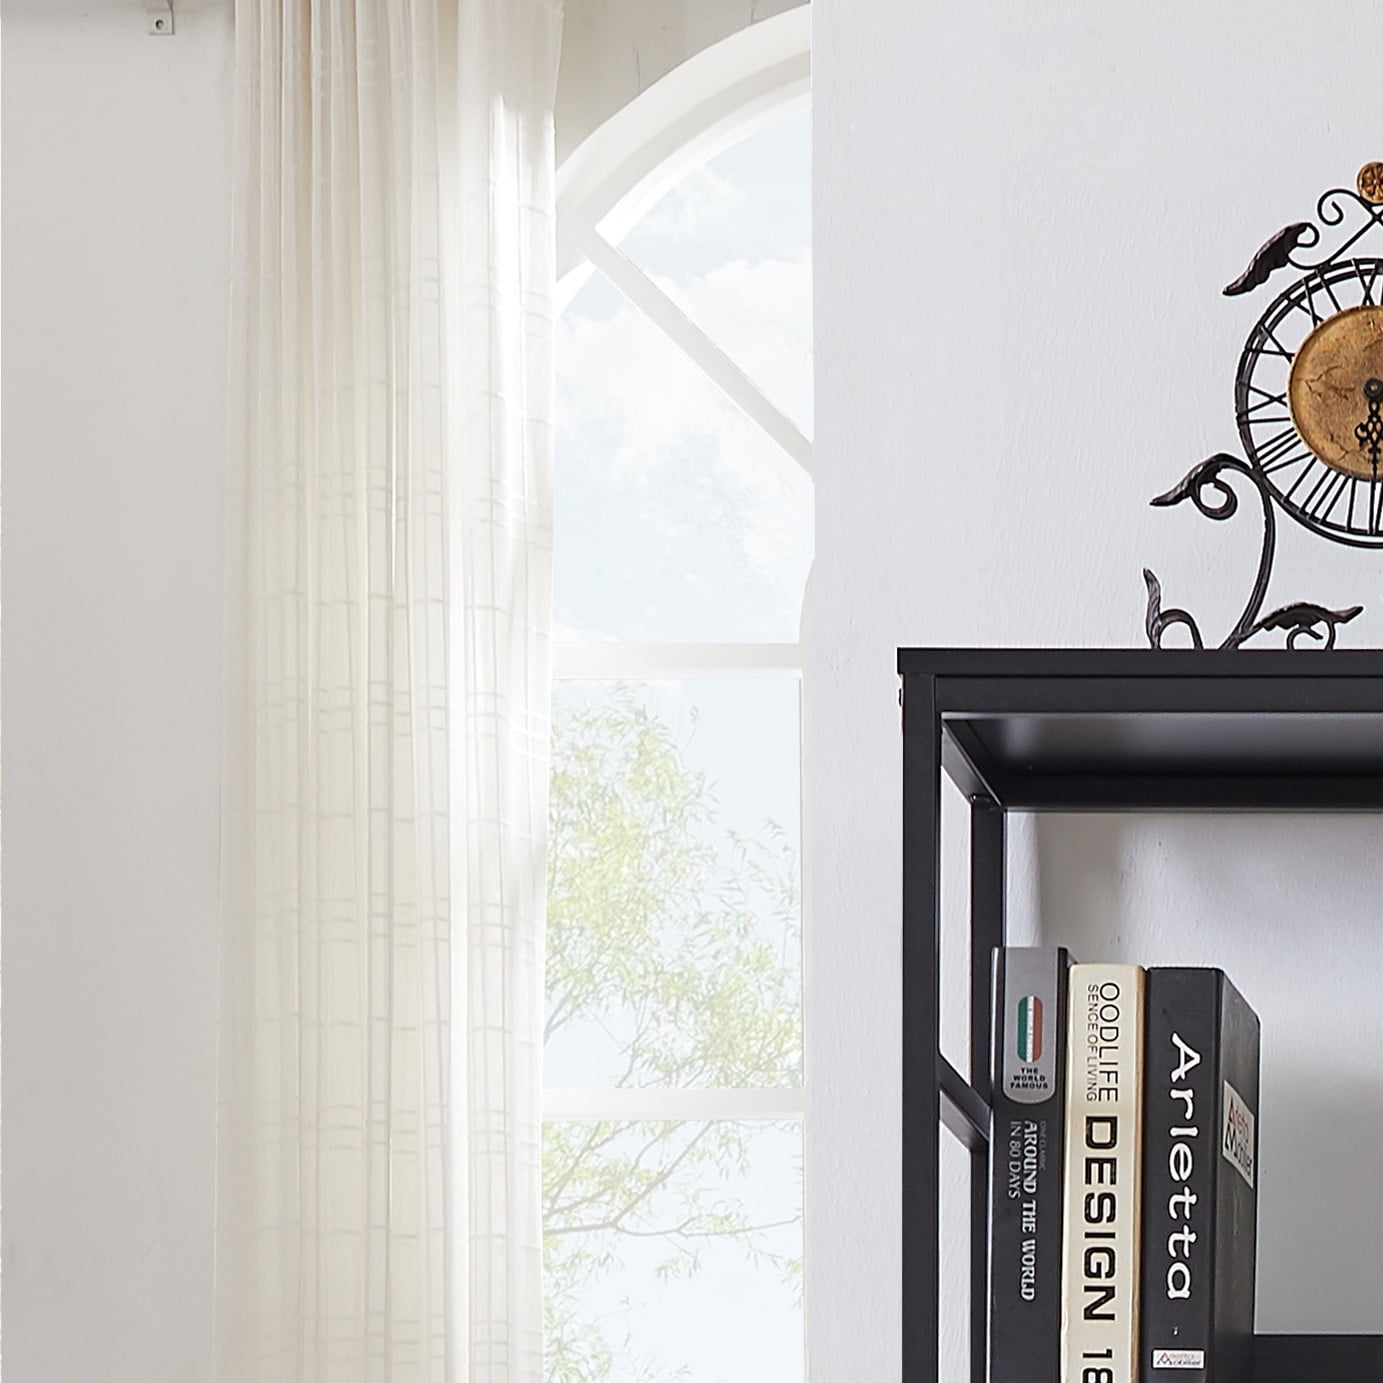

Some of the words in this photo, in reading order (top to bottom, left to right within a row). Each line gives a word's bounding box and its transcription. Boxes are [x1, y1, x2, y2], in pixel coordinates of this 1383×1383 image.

[1087, 984, 1099, 1031] SENCE
[1087, 1034, 1099, 1053] OF
[1098, 982, 1120, 1102] OODLIFE
[1010, 1082, 1049, 1090] FAMOUS
[1013, 1074, 1046, 1082] WORLD
[1086, 1056, 1098, 1102] LIVING
[1009, 1139, 1021, 1158] 80
[1010, 1121, 1022, 1137] IN
[1022, 1120, 1038, 1194] AROUND
[1166, 1032, 1203, 1300] Arletta
[1008, 1161, 1021, 1199] DAYS
[1021, 1199, 1037, 1233] THE
[1081, 1116, 1119, 1322] DESIGN
[1020, 1239, 1036, 1301] WORLD
